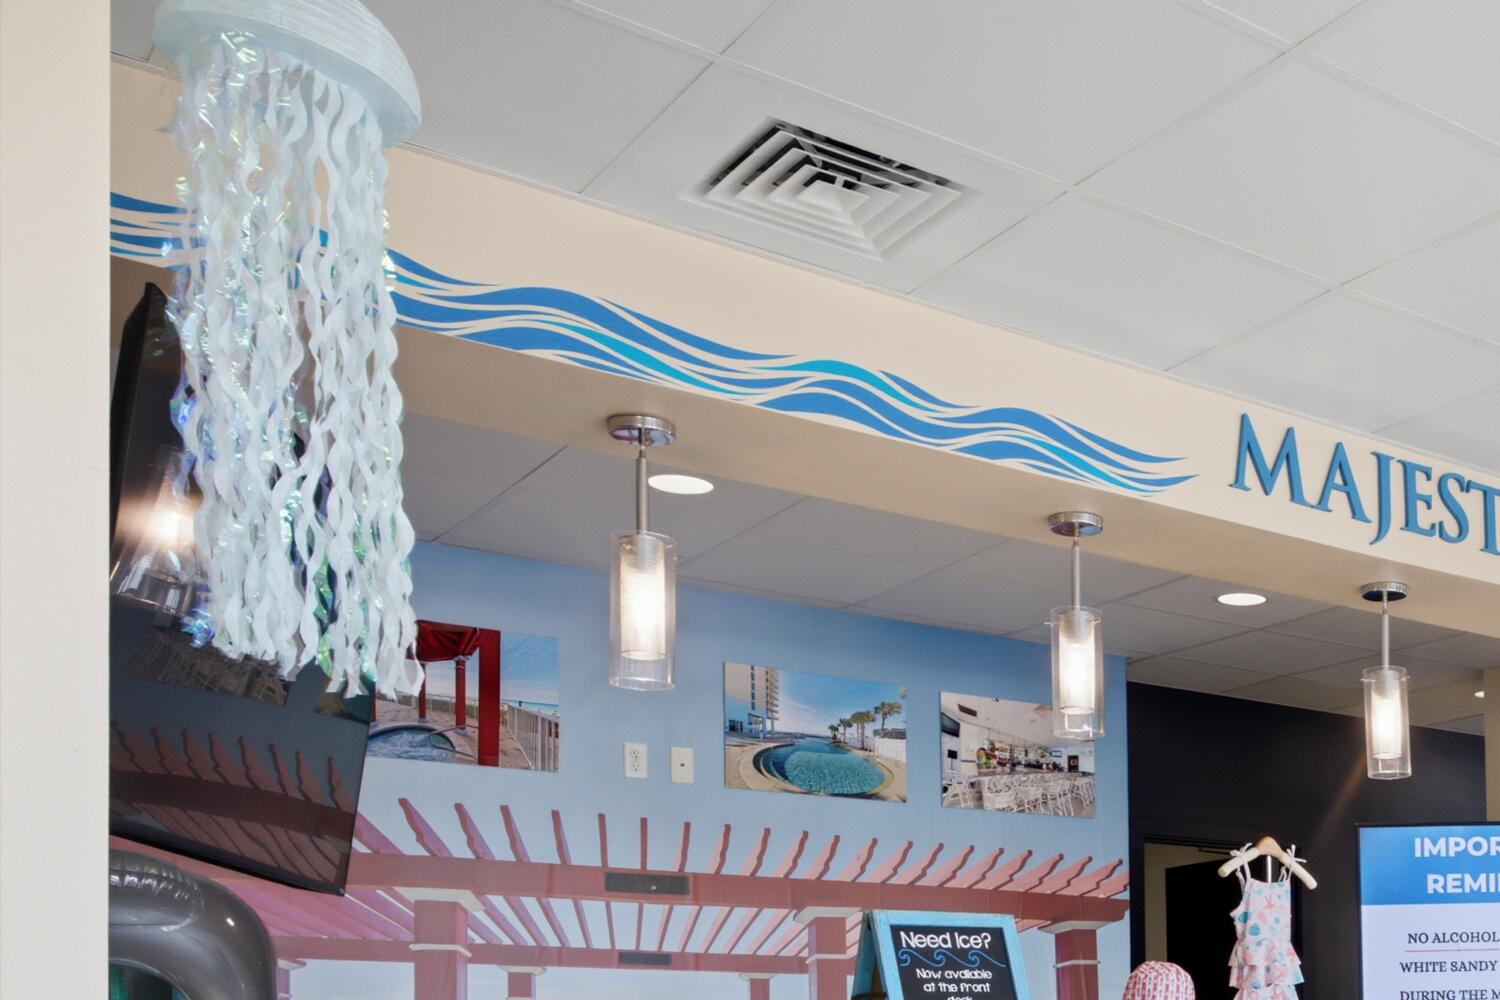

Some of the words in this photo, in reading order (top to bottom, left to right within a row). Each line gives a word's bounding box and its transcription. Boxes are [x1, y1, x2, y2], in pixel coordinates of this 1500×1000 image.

[900, 931, 953, 948] Need
[954, 931, 992, 949] Ice?
[1407, 932, 1429, 945] NO
[1432, 930, 1500, 944] ALCOHOL
[916, 967, 942, 979] Now
[944, 968, 993, 979] available
[1400, 961, 1447, 974] WHITE
[1450, 960, 1499, 973] SANDY
[923, 982, 936, 993] at
[938, 982, 958, 993] the
[960, 982, 991, 993] front
[1458, 989, 1489, 1000] THE
